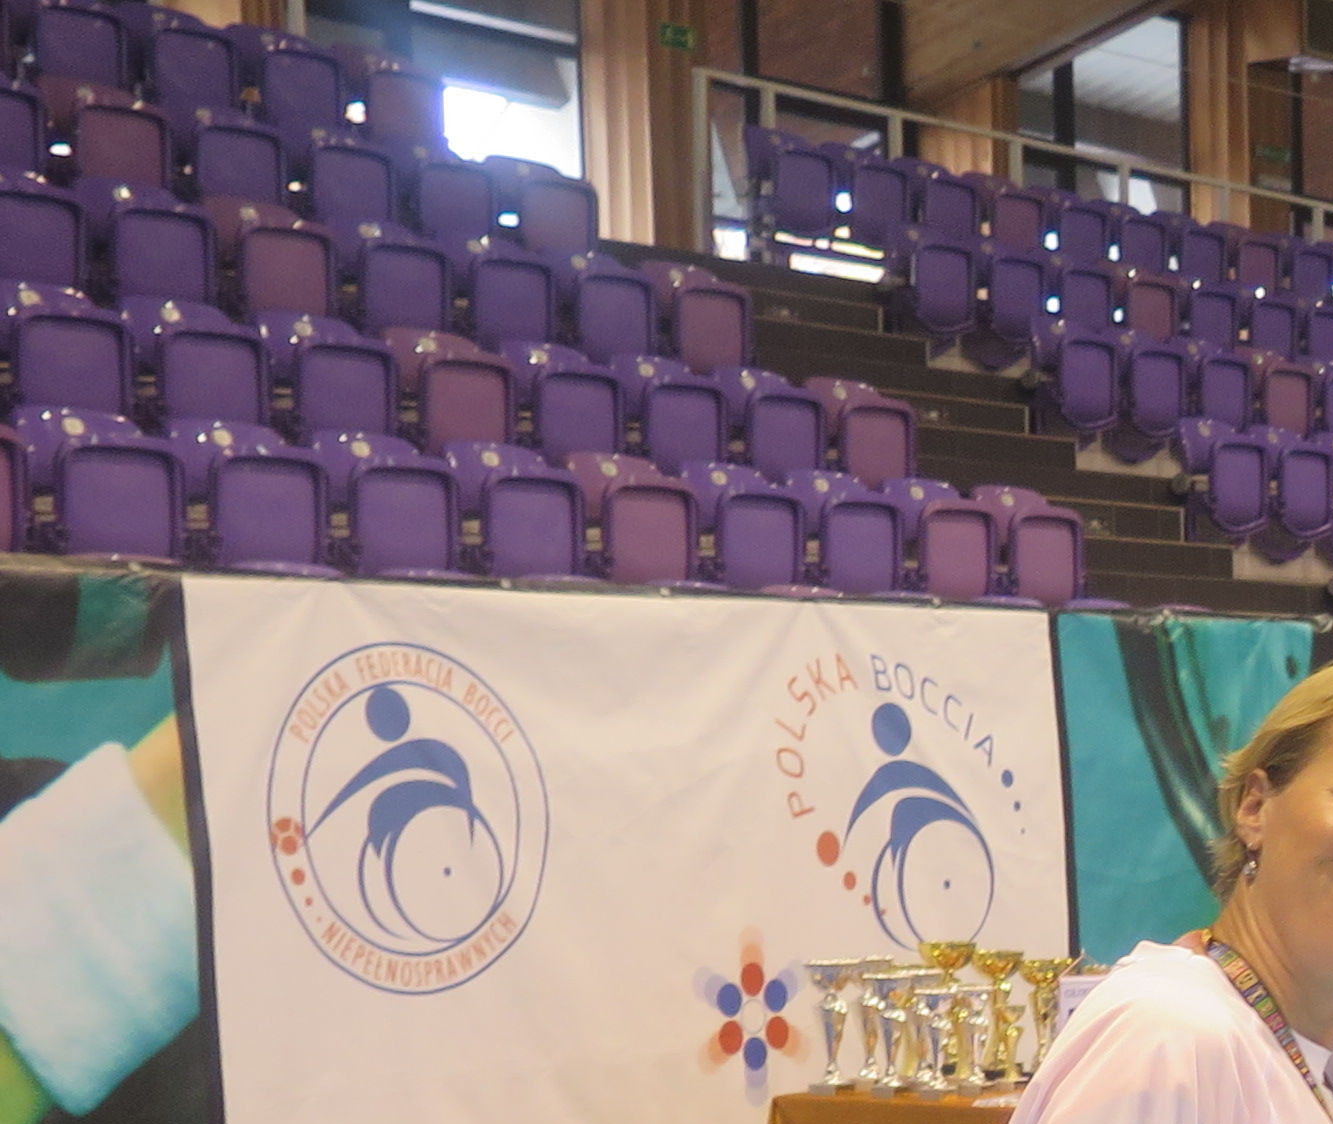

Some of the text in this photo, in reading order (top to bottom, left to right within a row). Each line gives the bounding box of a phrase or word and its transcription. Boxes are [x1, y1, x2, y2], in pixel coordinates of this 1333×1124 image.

[289, 651, 515, 744] POLSKA FEDERACJA BOCCI
[775, 652, 994, 820] POLSKA BOCCIA
[320, 908, 519, 988] NIEPEŁNOSPRAWNYCH
